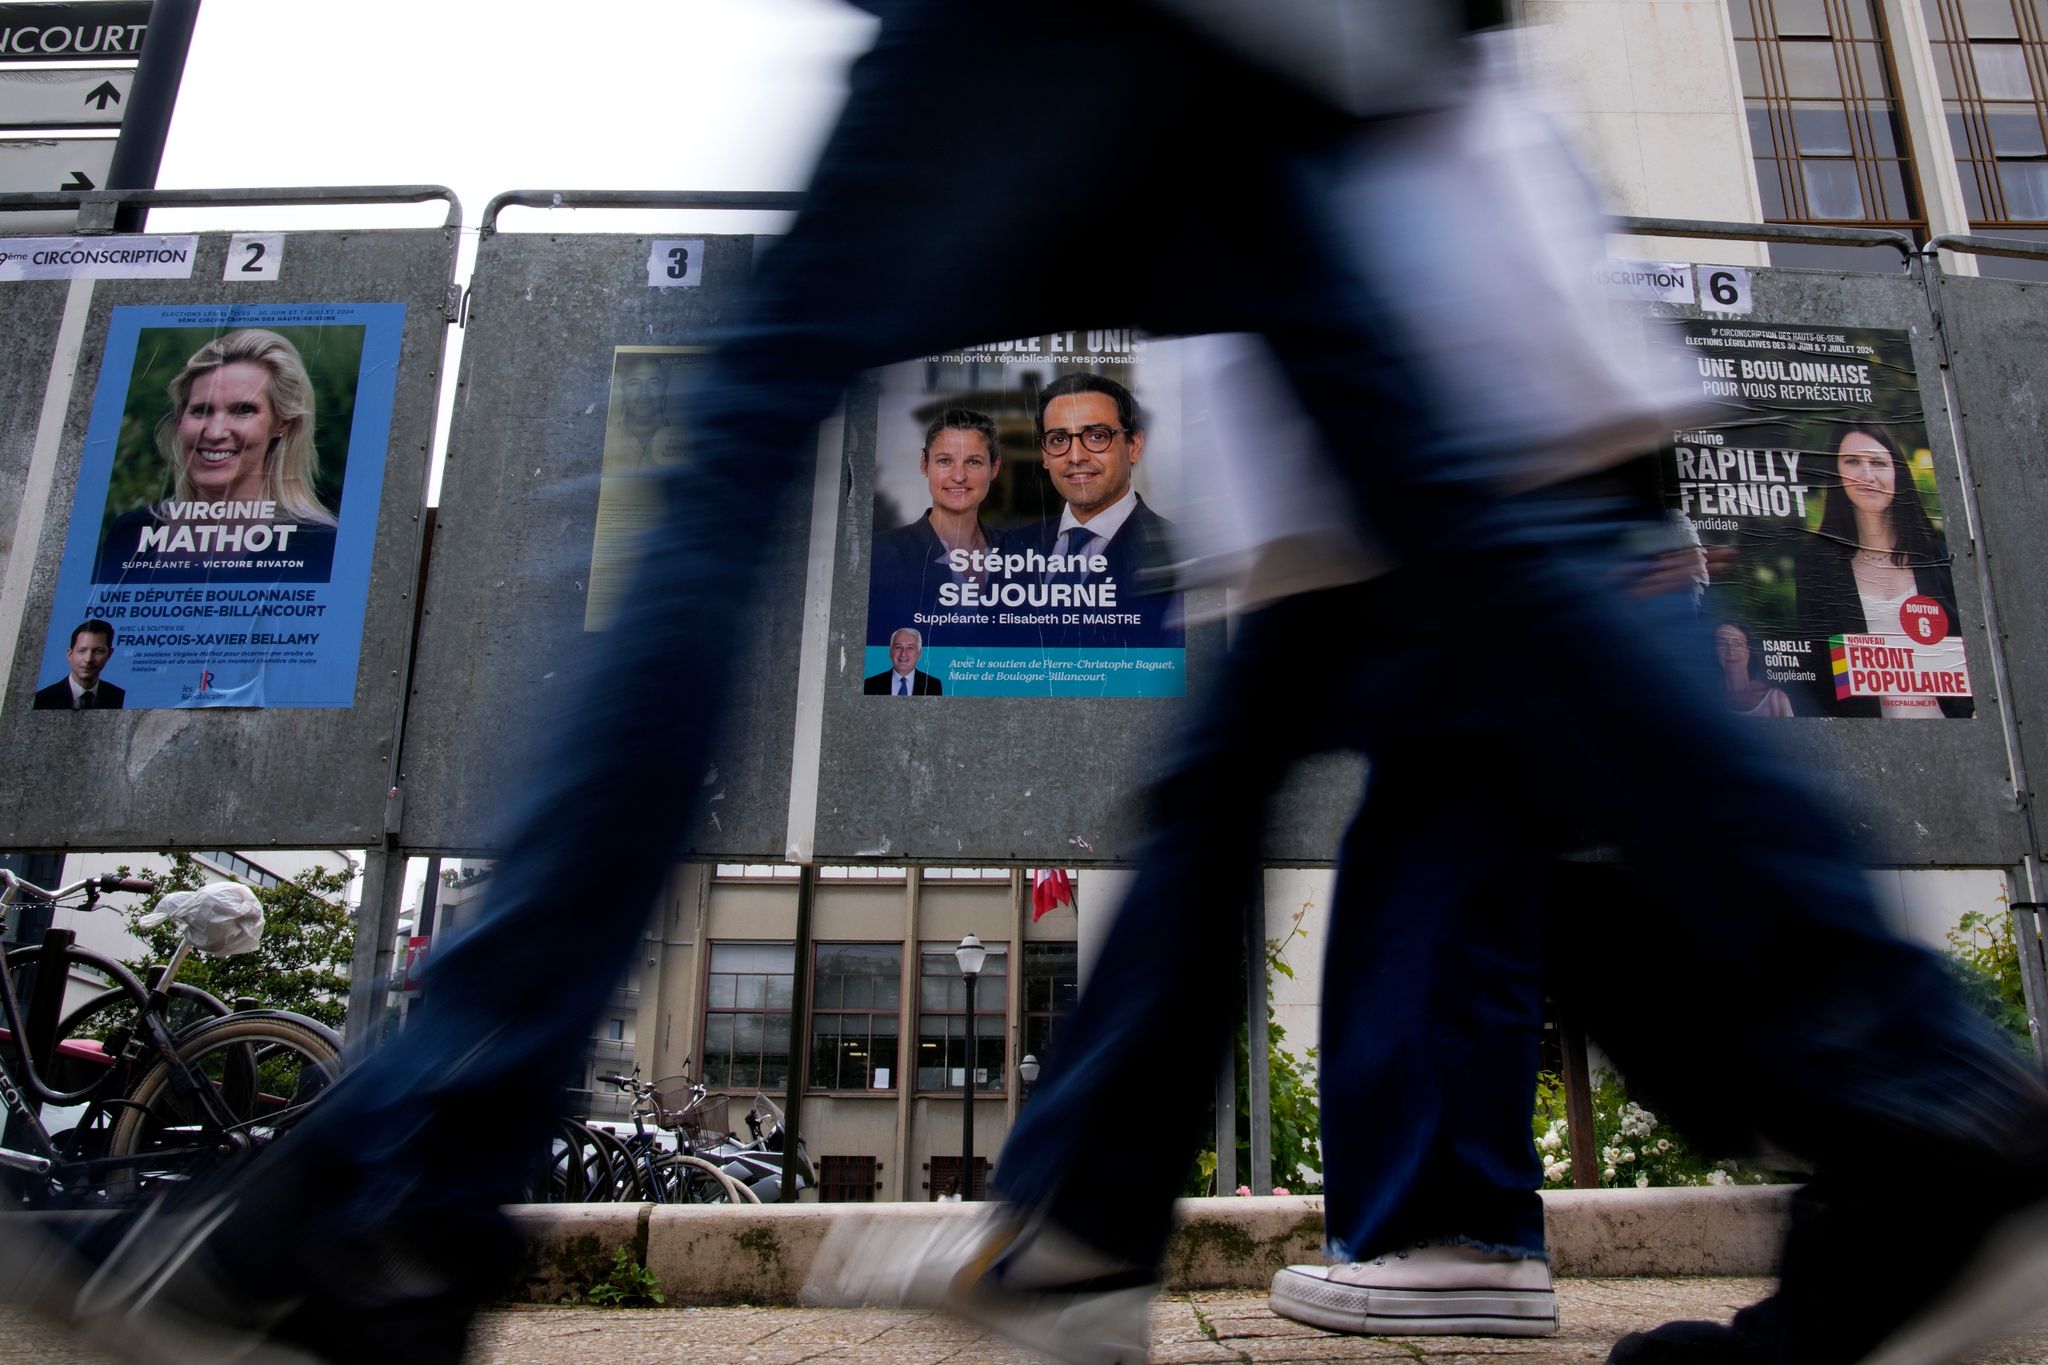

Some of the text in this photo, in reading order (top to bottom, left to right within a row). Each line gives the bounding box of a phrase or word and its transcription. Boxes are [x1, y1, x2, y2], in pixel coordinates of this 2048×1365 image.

[33, 249, 187, 265] CIRCONSCRIPTION
[241, 243, 266, 272] 2
[667, 248, 688, 279] 3
[1590, 270, 1685, 289] NSCRIPTION
[1710, 271, 1739, 305] 6
[1720, 328, 1777, 339] CIRCONSCRIPTION
[1779, 331, 1792, 340] DES
[1793, 332, 1846, 343] HAUTS-DE-SEINE
[1685, 335, 1724, 346] ÉLECTIONS
[1724, 337, 1771, 349] LÉGISLATIVES
[1772, 341, 1785, 350] DES
[1797, 342, 1813, 351] JUIN
[1828, 345, 1855, 353] JUILLET
[1856, 346, 1874, 354] 2024
[942, 353, 991, 364] majorité
[994, 353, 1069, 364] républicaine
[1072, 354, 1147, 365] responsable
[1697, 357, 1871, 385] UNE BOULONNAISE
[1702, 380, 1873, 403] POUR VOUS REPRÉSENTER
[1673, 430, 1724, 446] Pauline
[1674, 447, 1800, 483] RAPILLY
[1679, 482, 1809, 518] FERNIOT
[168, 500, 276, 520] VIRGINIE
[1691, 517, 1739, 531] andidate
[136, 524, 297, 552] MATHOT
[121, 559, 191, 569] SUPPLÉANTE
[203, 560, 253, 568] VICTOIRE
[256, 560, 304, 568] RIVATON
[949, 548, 1108, 579] Stéphane
[100, 588, 316, 603] UNE DÉPUTÉE BOULONNAISE
[939, 577, 1117, 608] SÉJOURNÉ
[84, 604, 327, 618] POUR BOULOGNE-BILLANCOURT
[1906, 604, 1939, 616] BOUTON
[914, 612, 989, 626] Suppléante
[999, 612, 1059, 625] Elisabeth
[1062, 614, 1080, 625] DE
[1083, 614, 1142, 625] MAISTRE
[1918, 617, 1932, 638] 6
[116, 633, 320, 648] FRANÇOIS-XAVIER BELLAMY
[1763, 640, 1811, 653] ISABELLE
[1847, 636, 1886, 646] NOUVEAU
[949, 658, 1175, 671] Avec le soutien de Pierre-Christophe Baguet,
[1765, 654, 1800, 668] GOÏTIA
[1850, 647, 1914, 670] FRONT
[949, 671, 1106, 683] Maire de Boulogne-Billancourt
[1767, 668, 1816, 683] Suppléante
[1852, 671, 1967, 694] POPULAIRE
[183, 684, 193, 693] les
